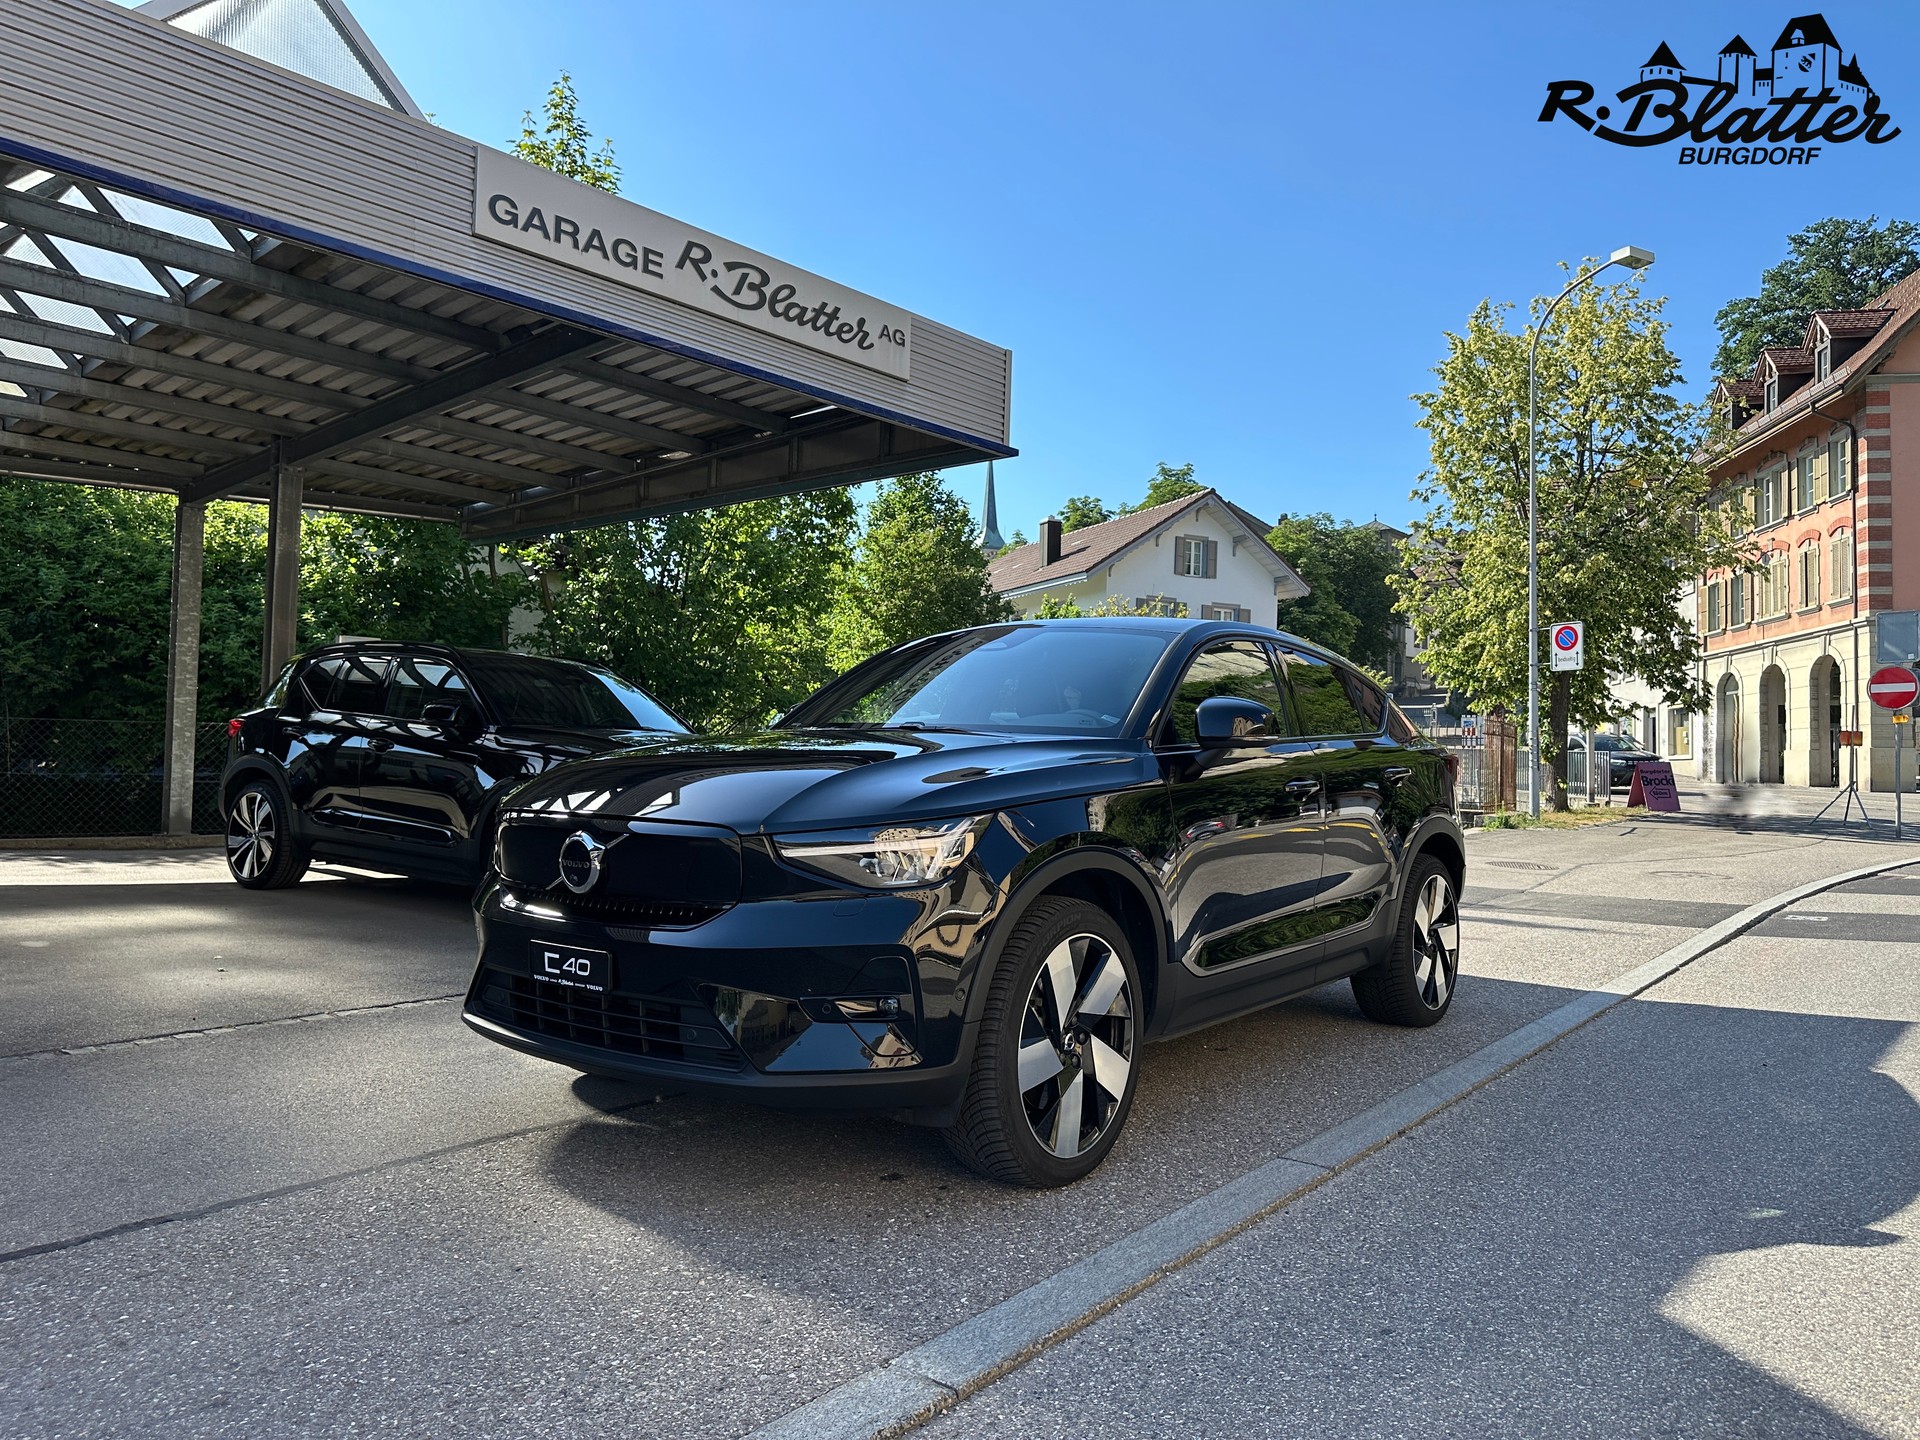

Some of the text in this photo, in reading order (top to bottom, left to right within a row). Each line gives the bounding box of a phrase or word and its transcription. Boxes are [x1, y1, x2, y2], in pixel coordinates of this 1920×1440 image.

[488, 194, 664, 279] GARAGE
[878, 324, 906, 347] AG
[562, 859, 590, 869] VOLVO
[544, 951, 591, 976] C40
